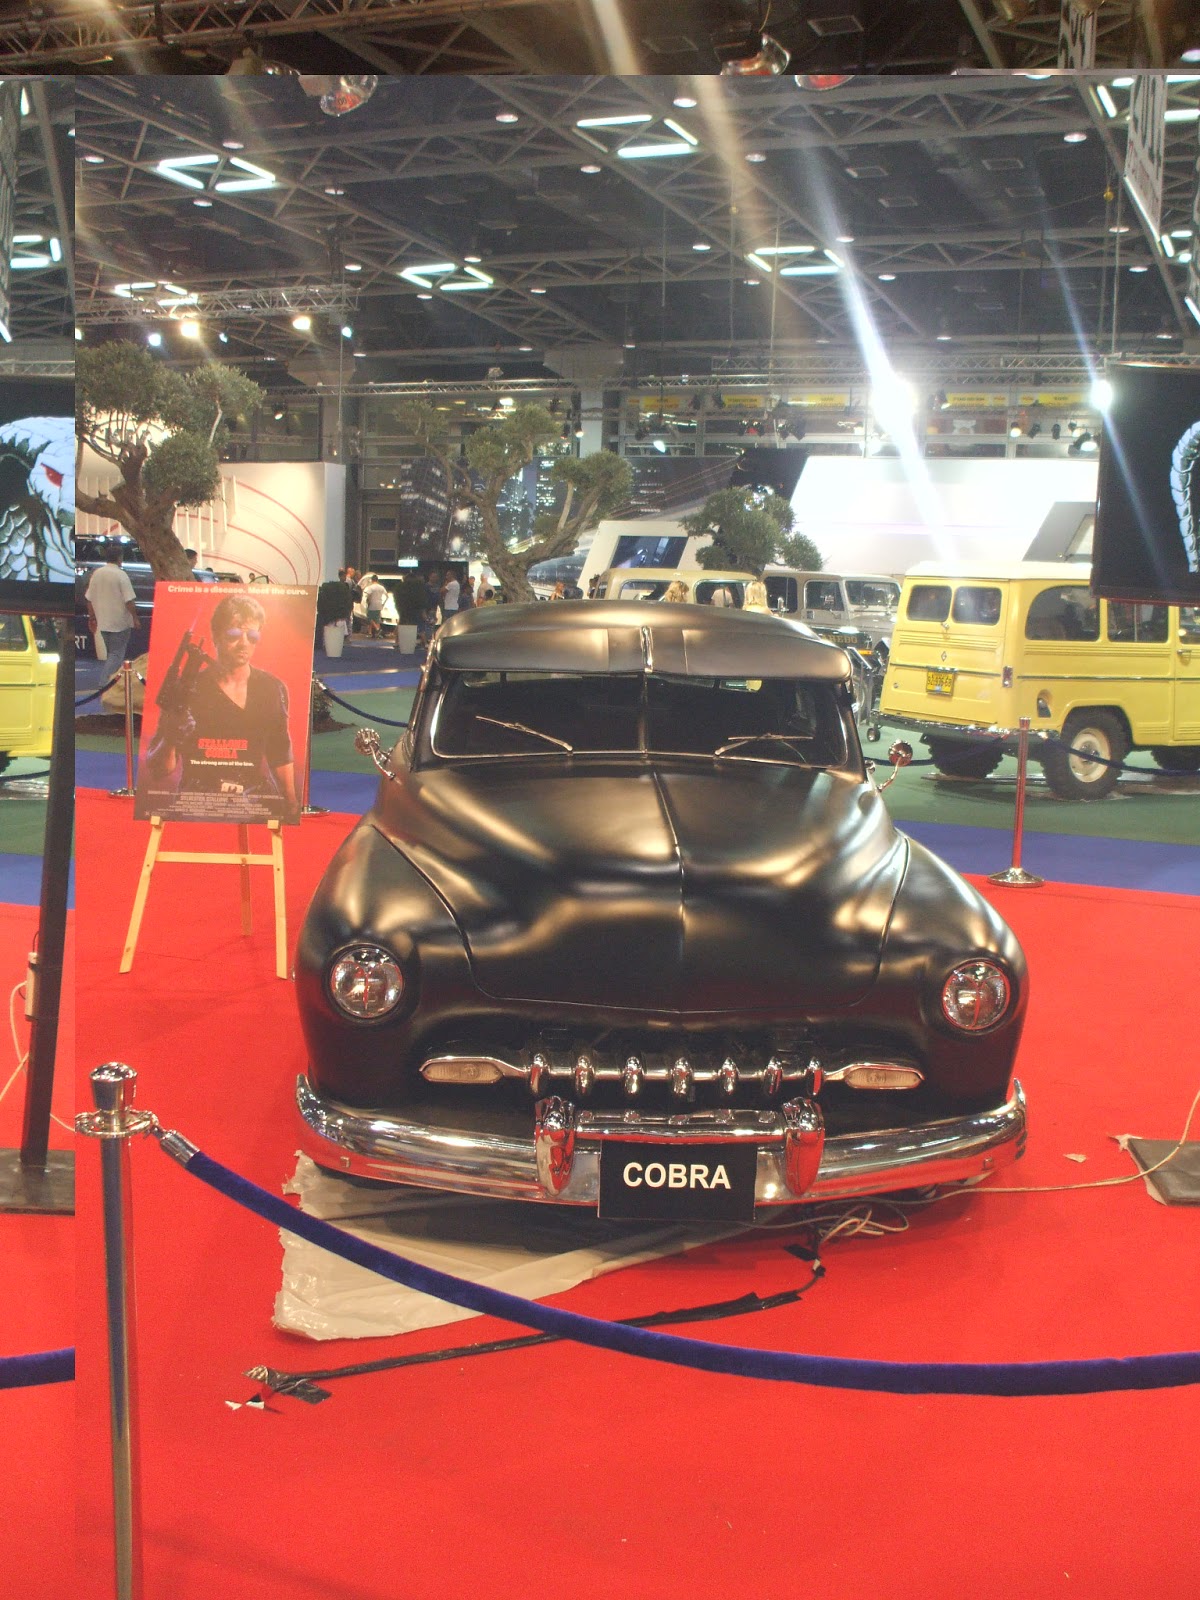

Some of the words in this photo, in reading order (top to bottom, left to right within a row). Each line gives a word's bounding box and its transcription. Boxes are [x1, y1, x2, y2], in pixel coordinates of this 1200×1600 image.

[168, 585, 193, 593] Crime
[195, 585, 202, 593] is
[210, 585, 246, 594] disease.
[248, 586, 269, 594] Meet
[271, 587, 285, 595] the
[286, 588, 309, 596] cure.
[623, 1162, 731, 1189] COBRA
